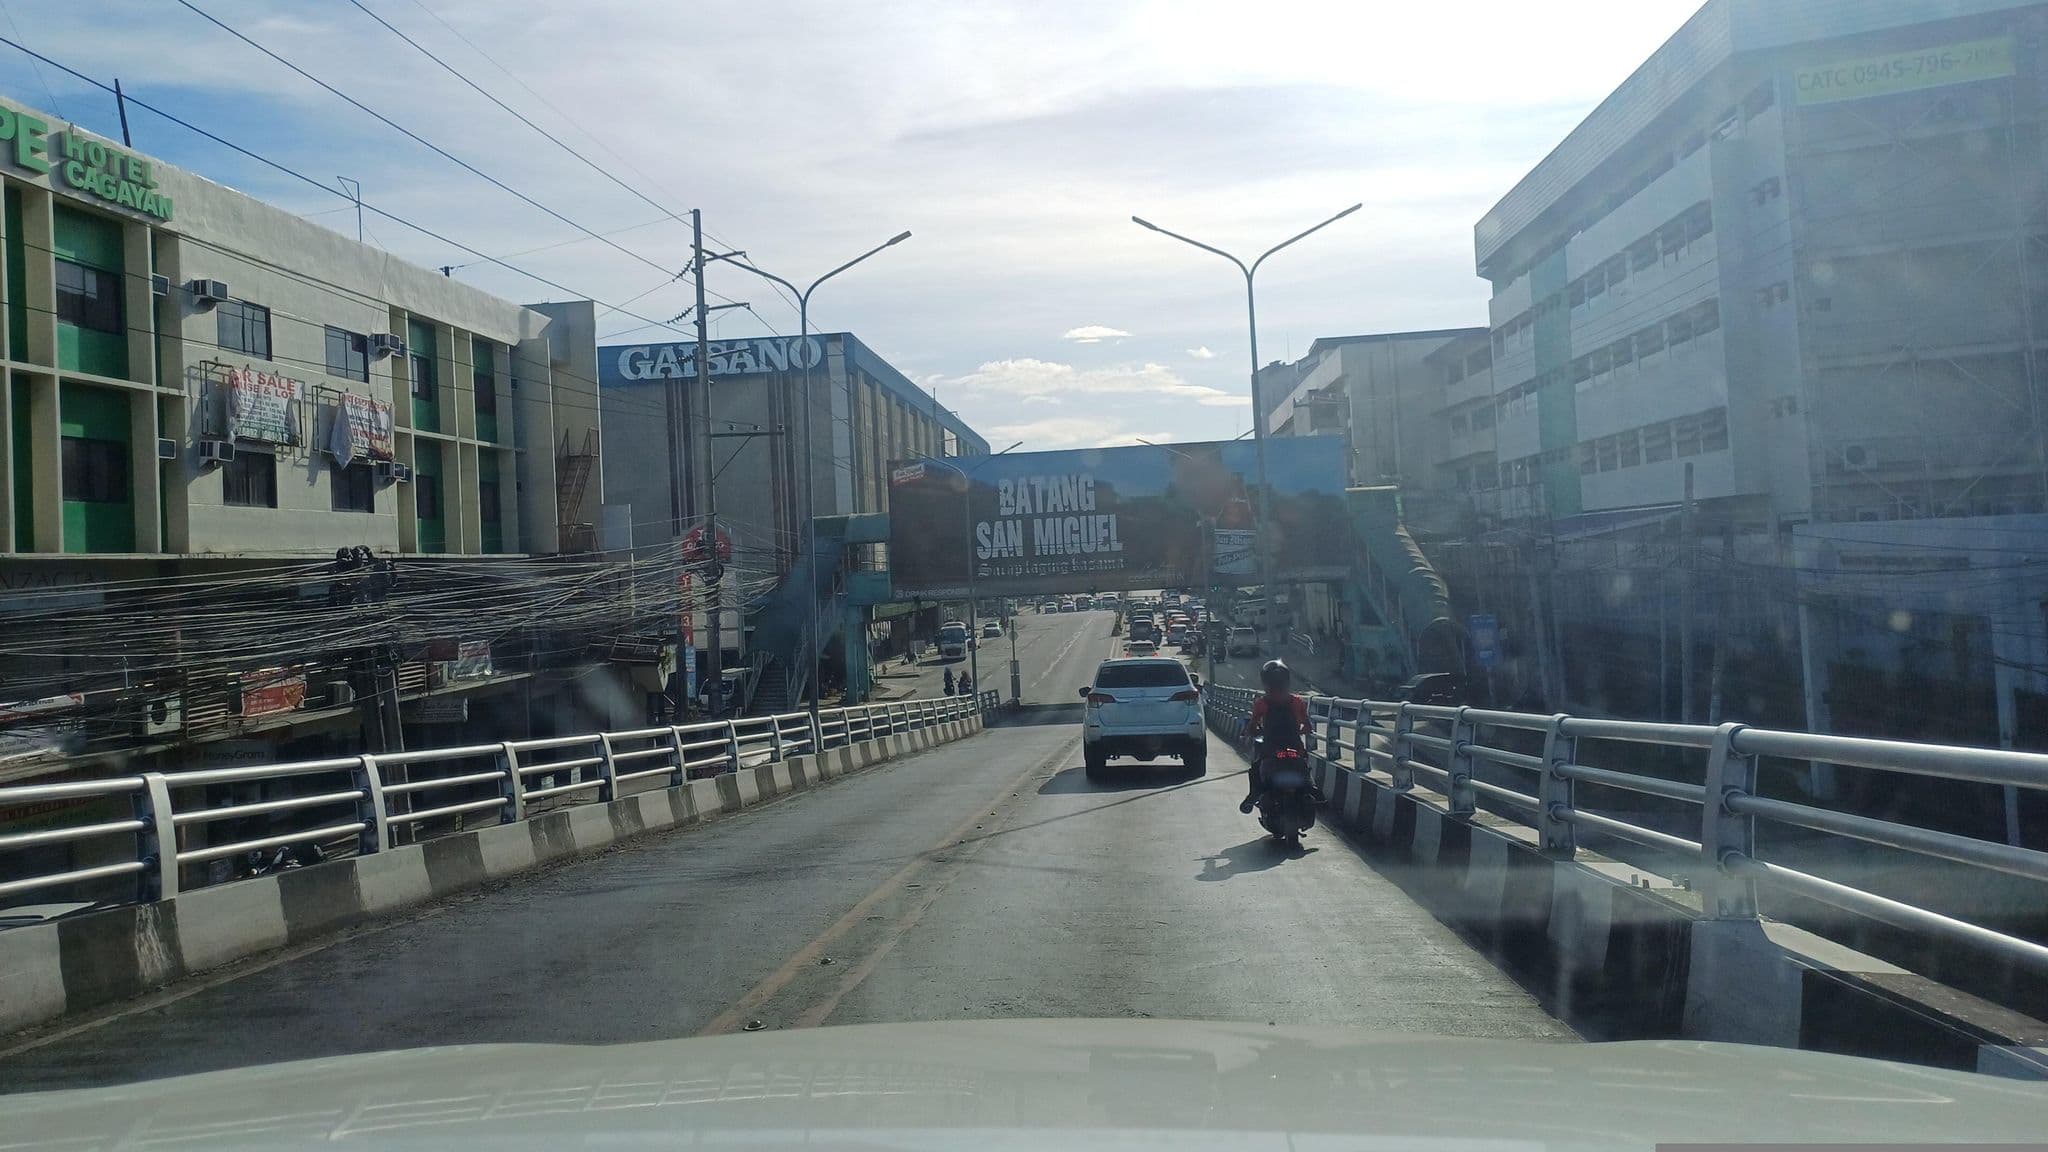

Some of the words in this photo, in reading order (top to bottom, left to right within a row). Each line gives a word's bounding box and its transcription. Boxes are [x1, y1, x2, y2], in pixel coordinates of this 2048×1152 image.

[62, 130, 159, 190] HOTEL
[64, 161, 173, 221] CAGAYAN
[618, 337, 822, 380] GAISANO
[257, 371, 296, 393] SALE
[999, 471, 1096, 516] BATANG
[976, 519, 1024, 560] SAN
[1033, 513, 1123, 556] MIGUEL
